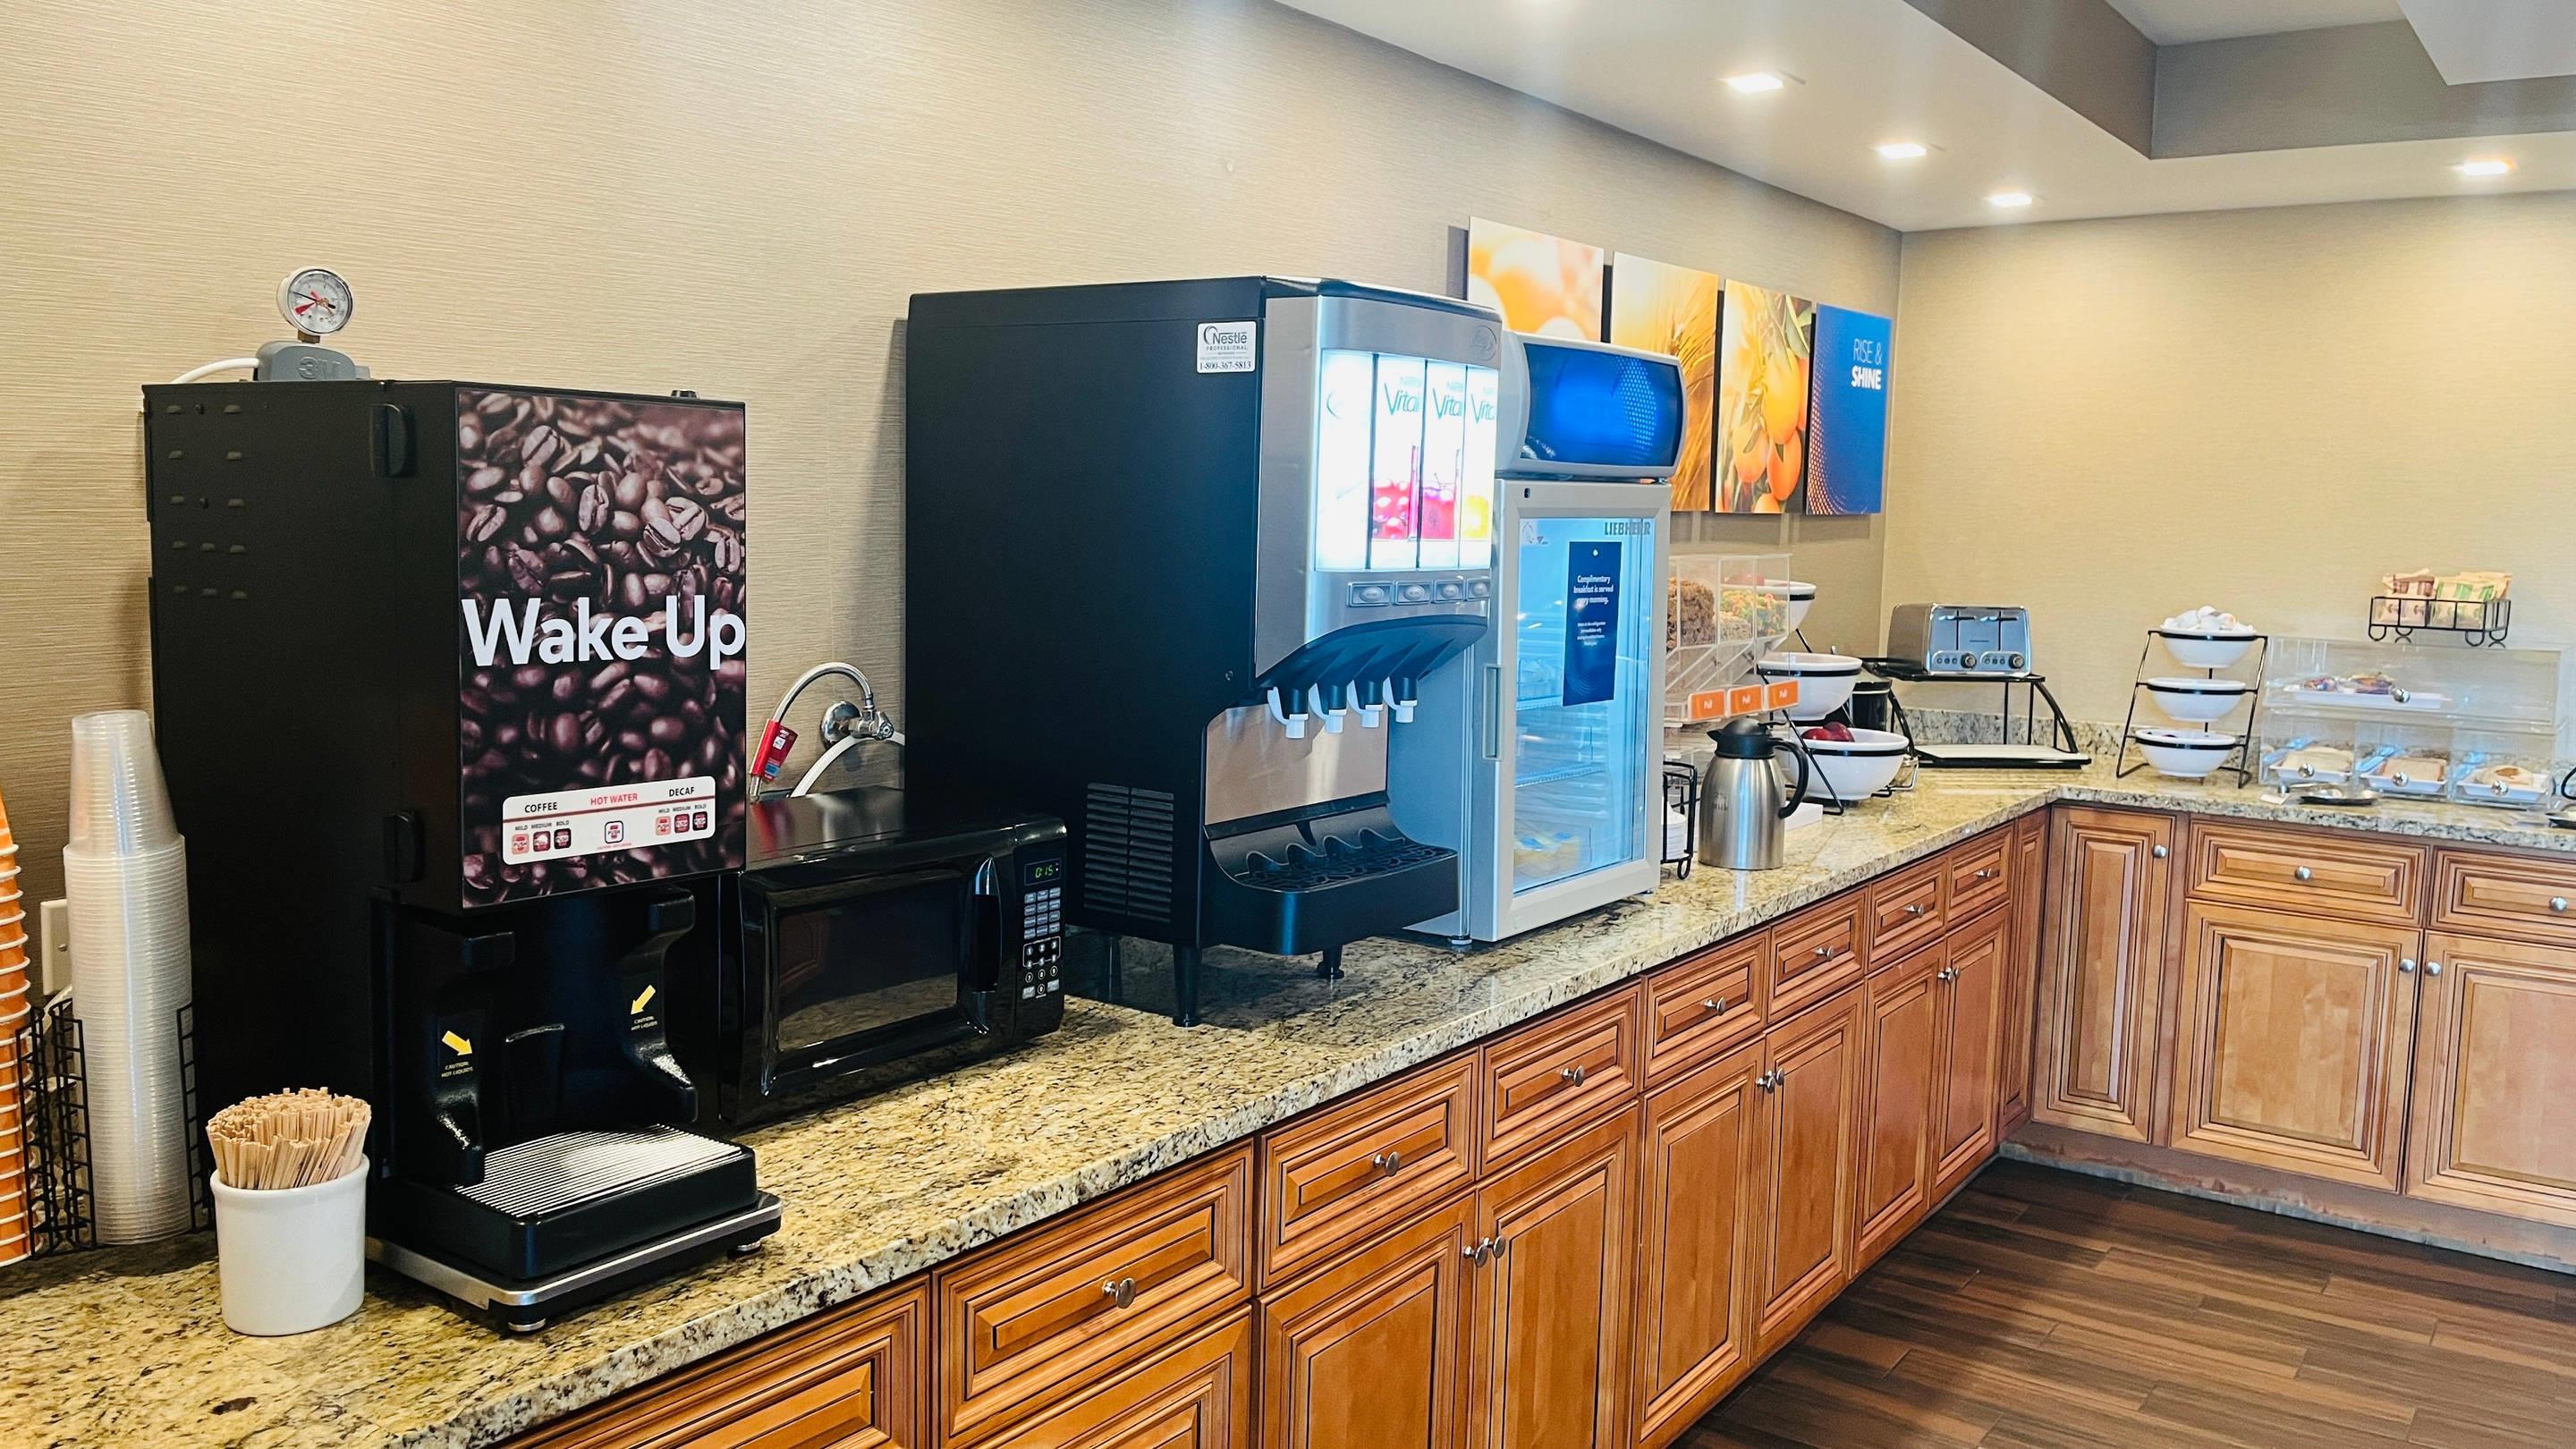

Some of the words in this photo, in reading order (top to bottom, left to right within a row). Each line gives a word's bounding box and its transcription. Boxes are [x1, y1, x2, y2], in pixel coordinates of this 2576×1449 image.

[1853, 338, 1874, 364] RISE
[1876, 342, 1883, 365] &
[1851, 365, 1882, 390] SHINE
[1604, 521, 1651, 536] LIEBHERR
[462, 596, 648, 667] Wake
[665, 594, 746, 671] Up
[590, 796, 608, 806] HOT
[610, 792, 639, 803] WATER
[668, 786, 695, 797] DECAF
[524, 801, 558, 813] COFFEE
